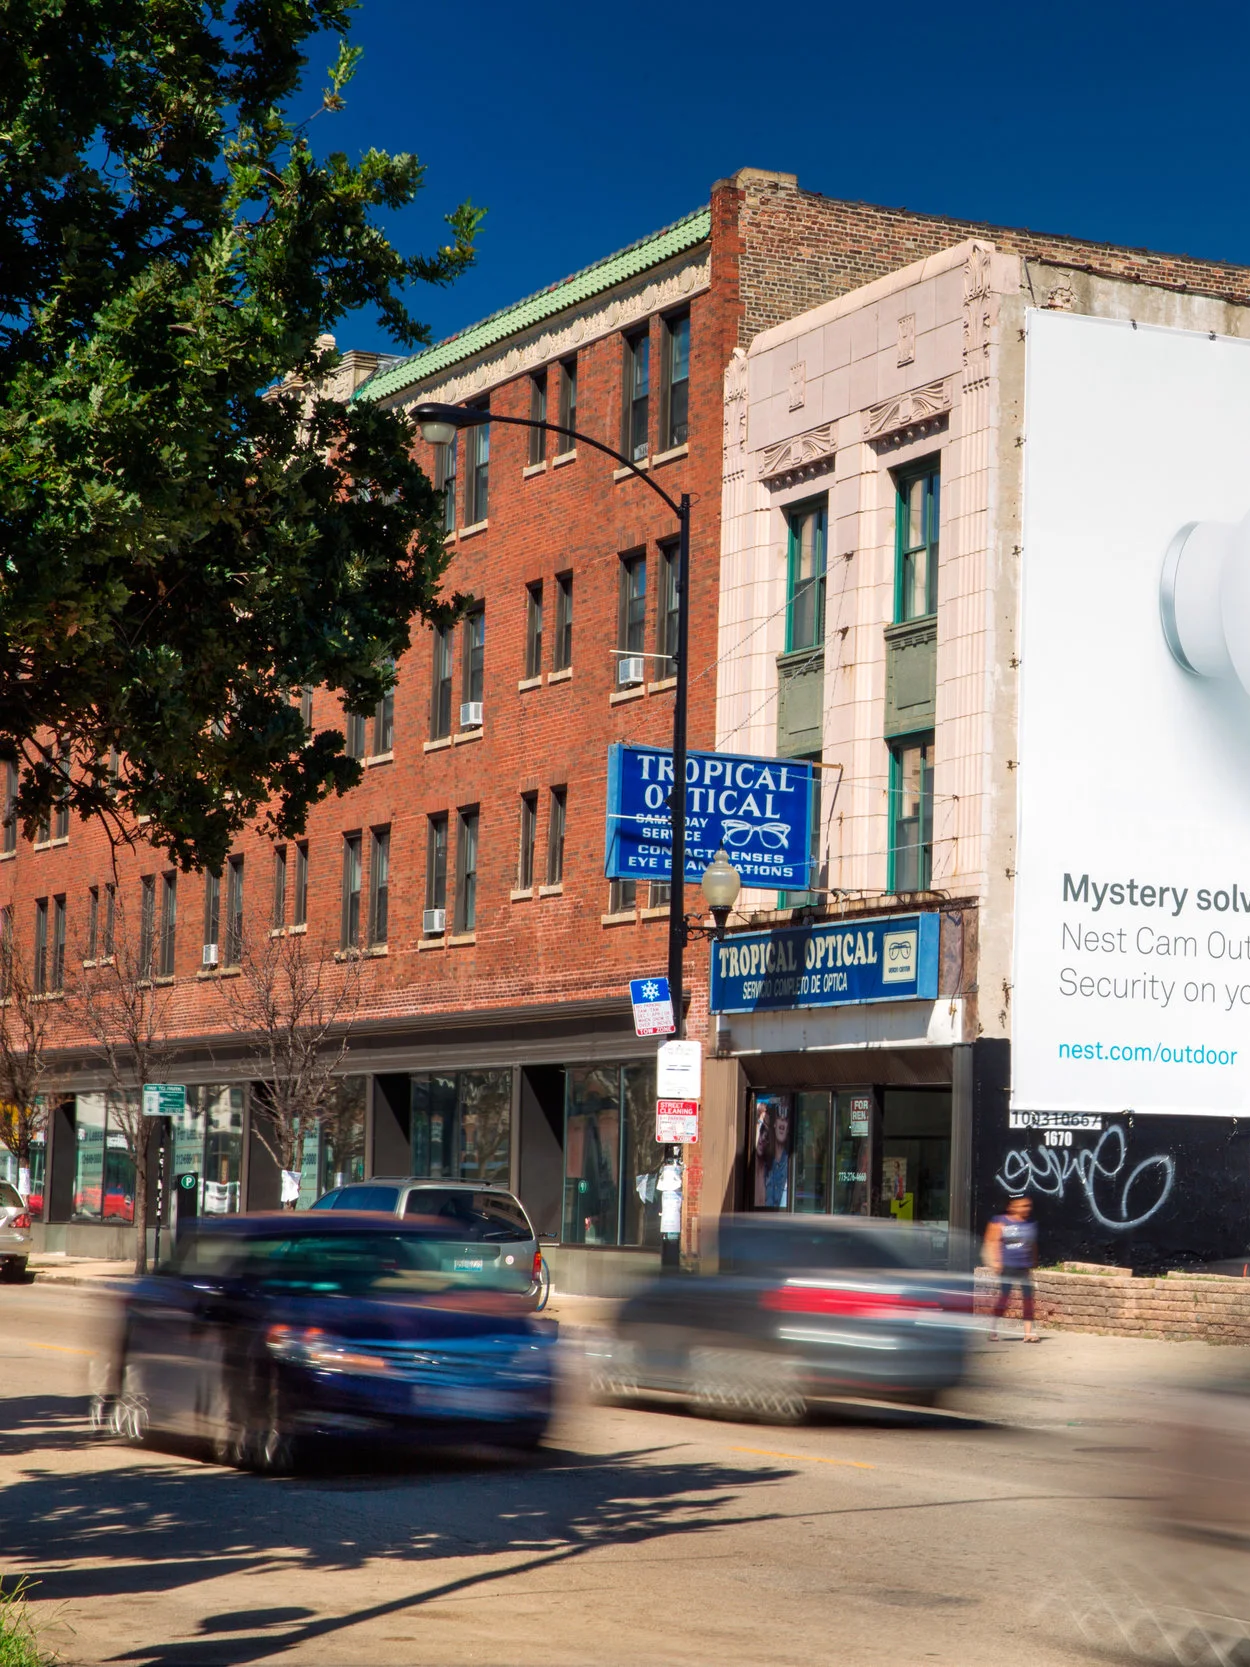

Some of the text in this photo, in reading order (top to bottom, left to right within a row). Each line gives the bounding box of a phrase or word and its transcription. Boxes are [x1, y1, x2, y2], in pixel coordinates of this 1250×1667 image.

[645, 784, 781, 819] OTICAL
[642, 828, 702, 841] SERVCE
[628, 856, 658, 868] EYE
[637, 845, 785, 864] CONACT ENSES
[1062, 873, 1188, 917] Mystery
[1062, 922, 1127, 953] Nest
[1136, 926, 1197, 957] Cam
[719, 931, 877, 978] TROPICAL OPTICAL
[743, 972, 848, 1000] SERVICIO COMPLETO DE OPTICA
[1059, 967, 1176, 1008] Security
[1184, 981, 1216, 1003] on
[656, 1025, 672, 1033] ZONE
[1059, 1041, 1238, 1065] nest.com/outdoor
[854, 1100, 869, 1110] FOR
[1044, 1131, 1073, 1146] 1670
